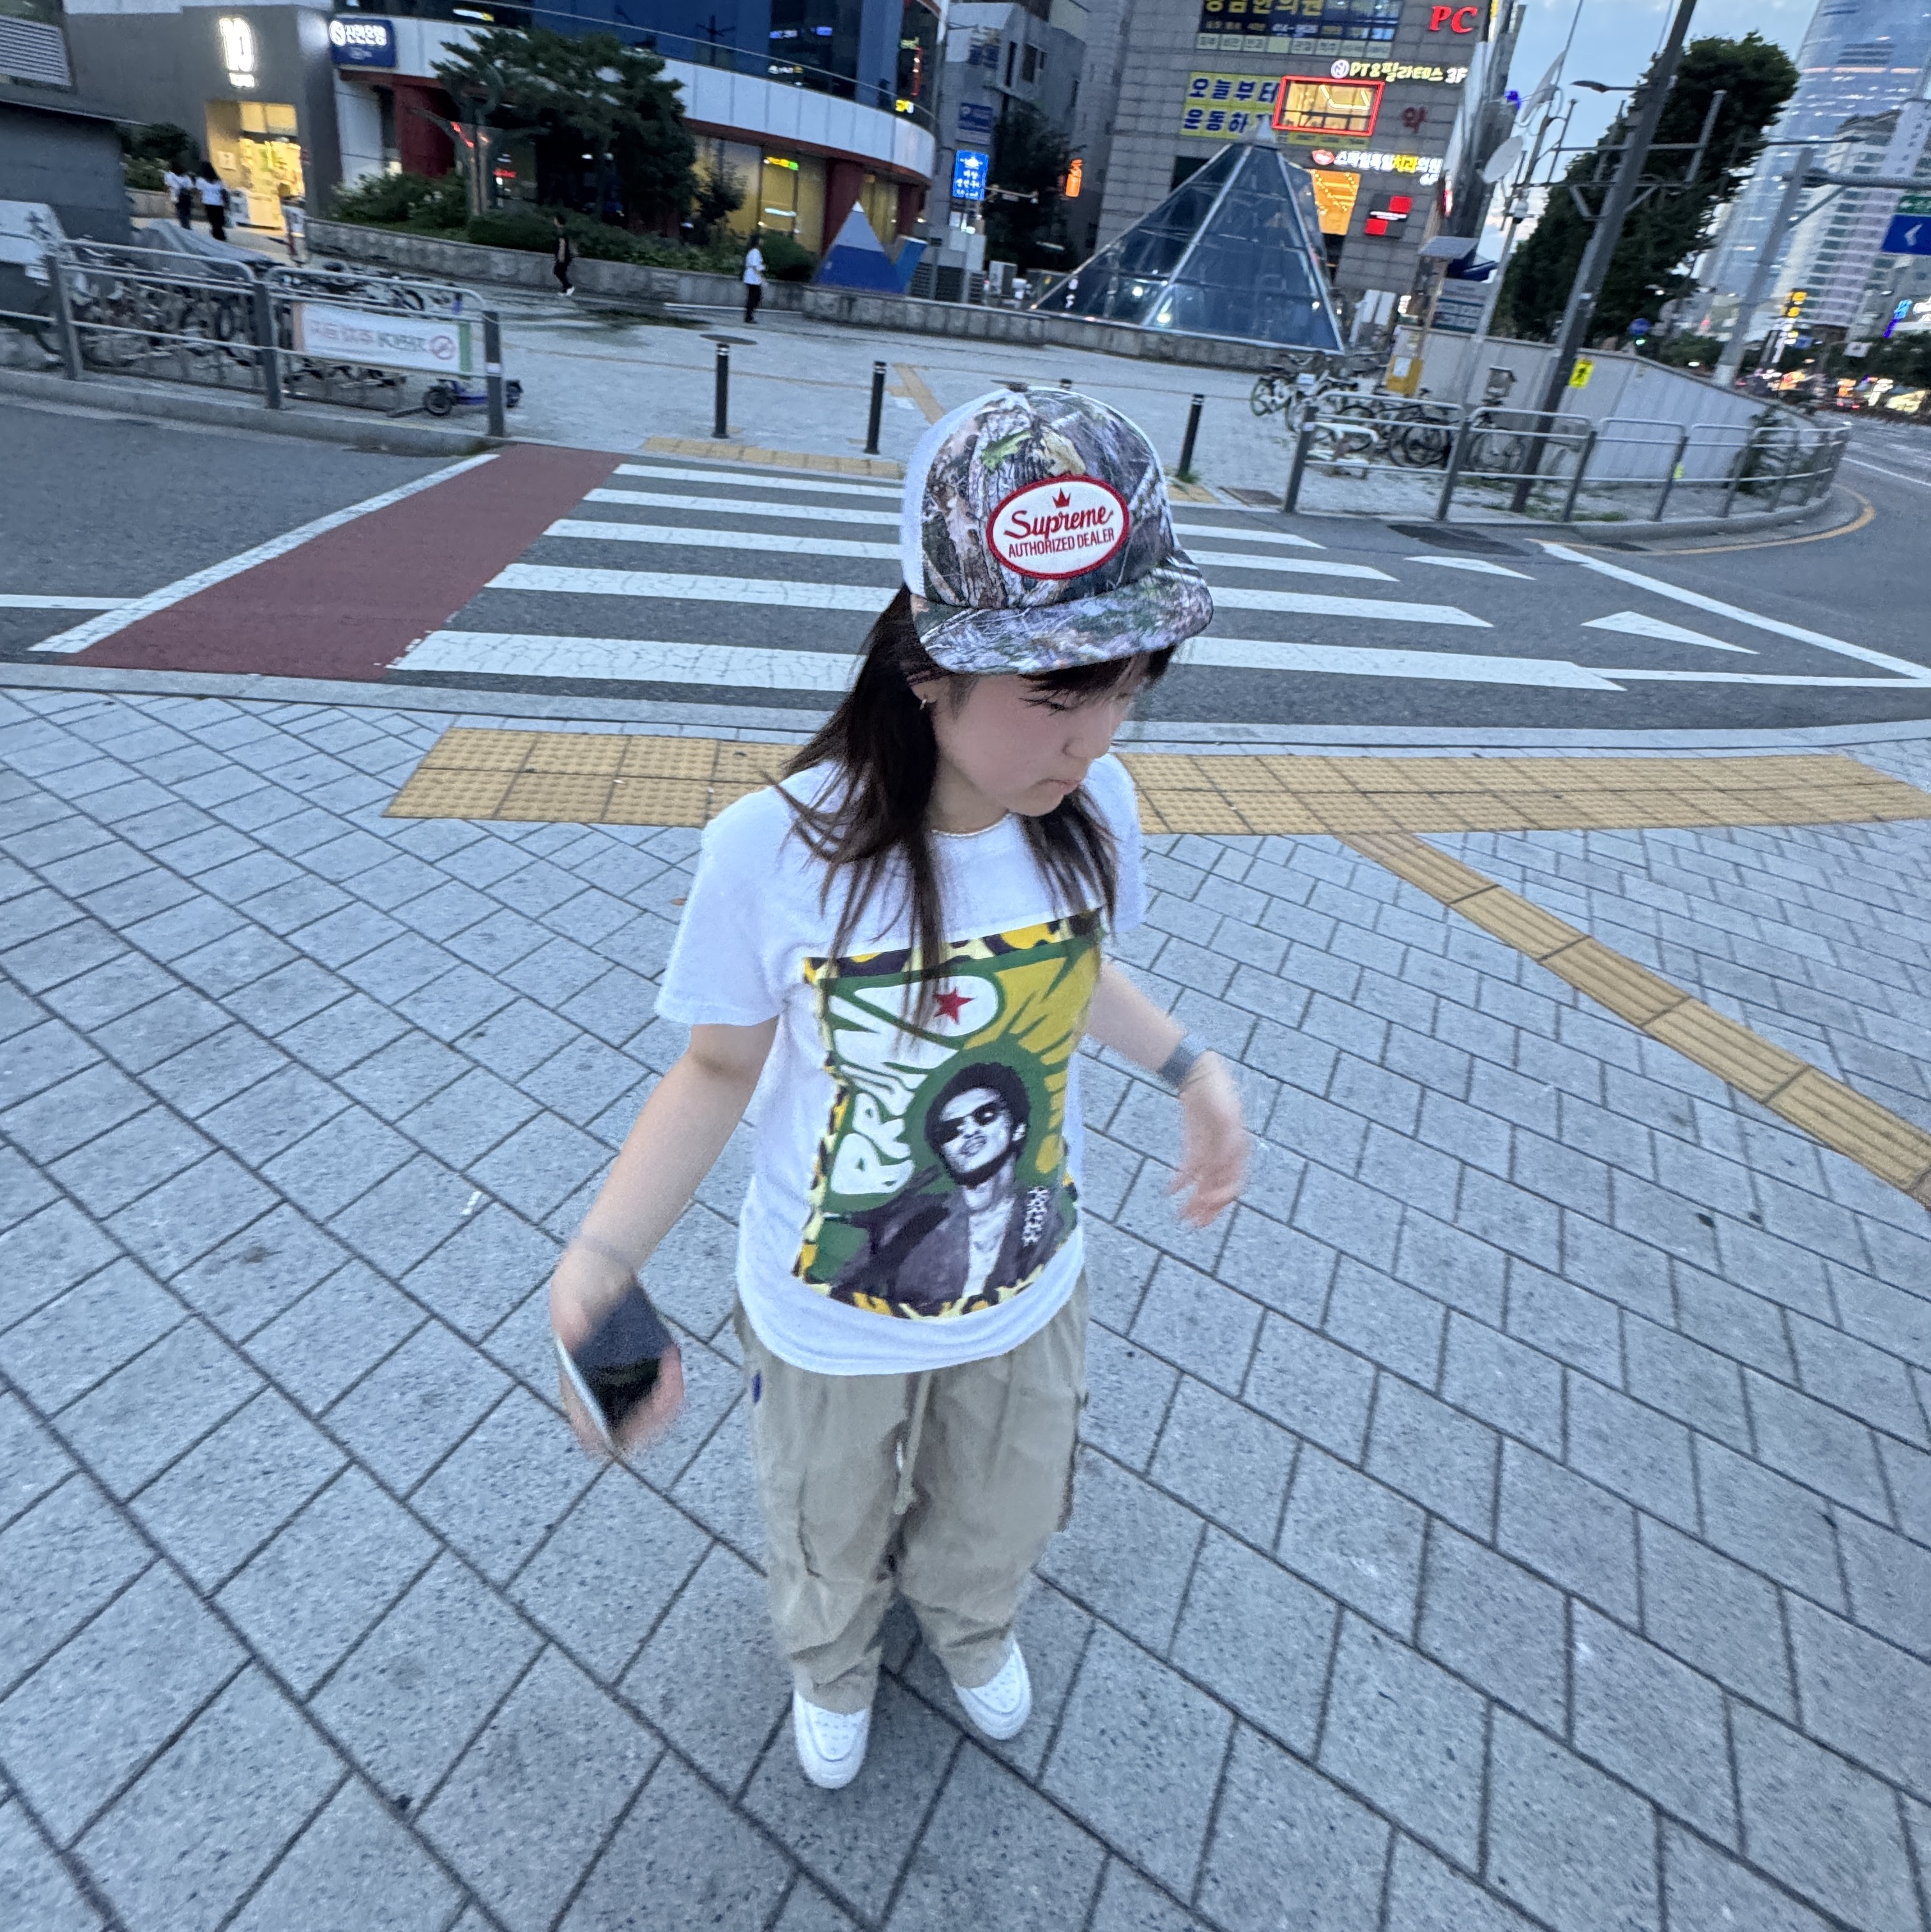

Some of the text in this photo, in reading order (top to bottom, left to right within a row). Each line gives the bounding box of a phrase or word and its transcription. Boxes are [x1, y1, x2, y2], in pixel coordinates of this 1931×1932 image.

[1430, 5, 1479, 33] PC
[346, 24, 387, 46] 신한은행
[1444, 66, 1469, 84] 3F
[1189, 77, 1279, 103] 오늘부터
[1004, 505, 1114, 540] Supreme
[1009, 528, 1115, 558] AUTHORIZED DEALER
